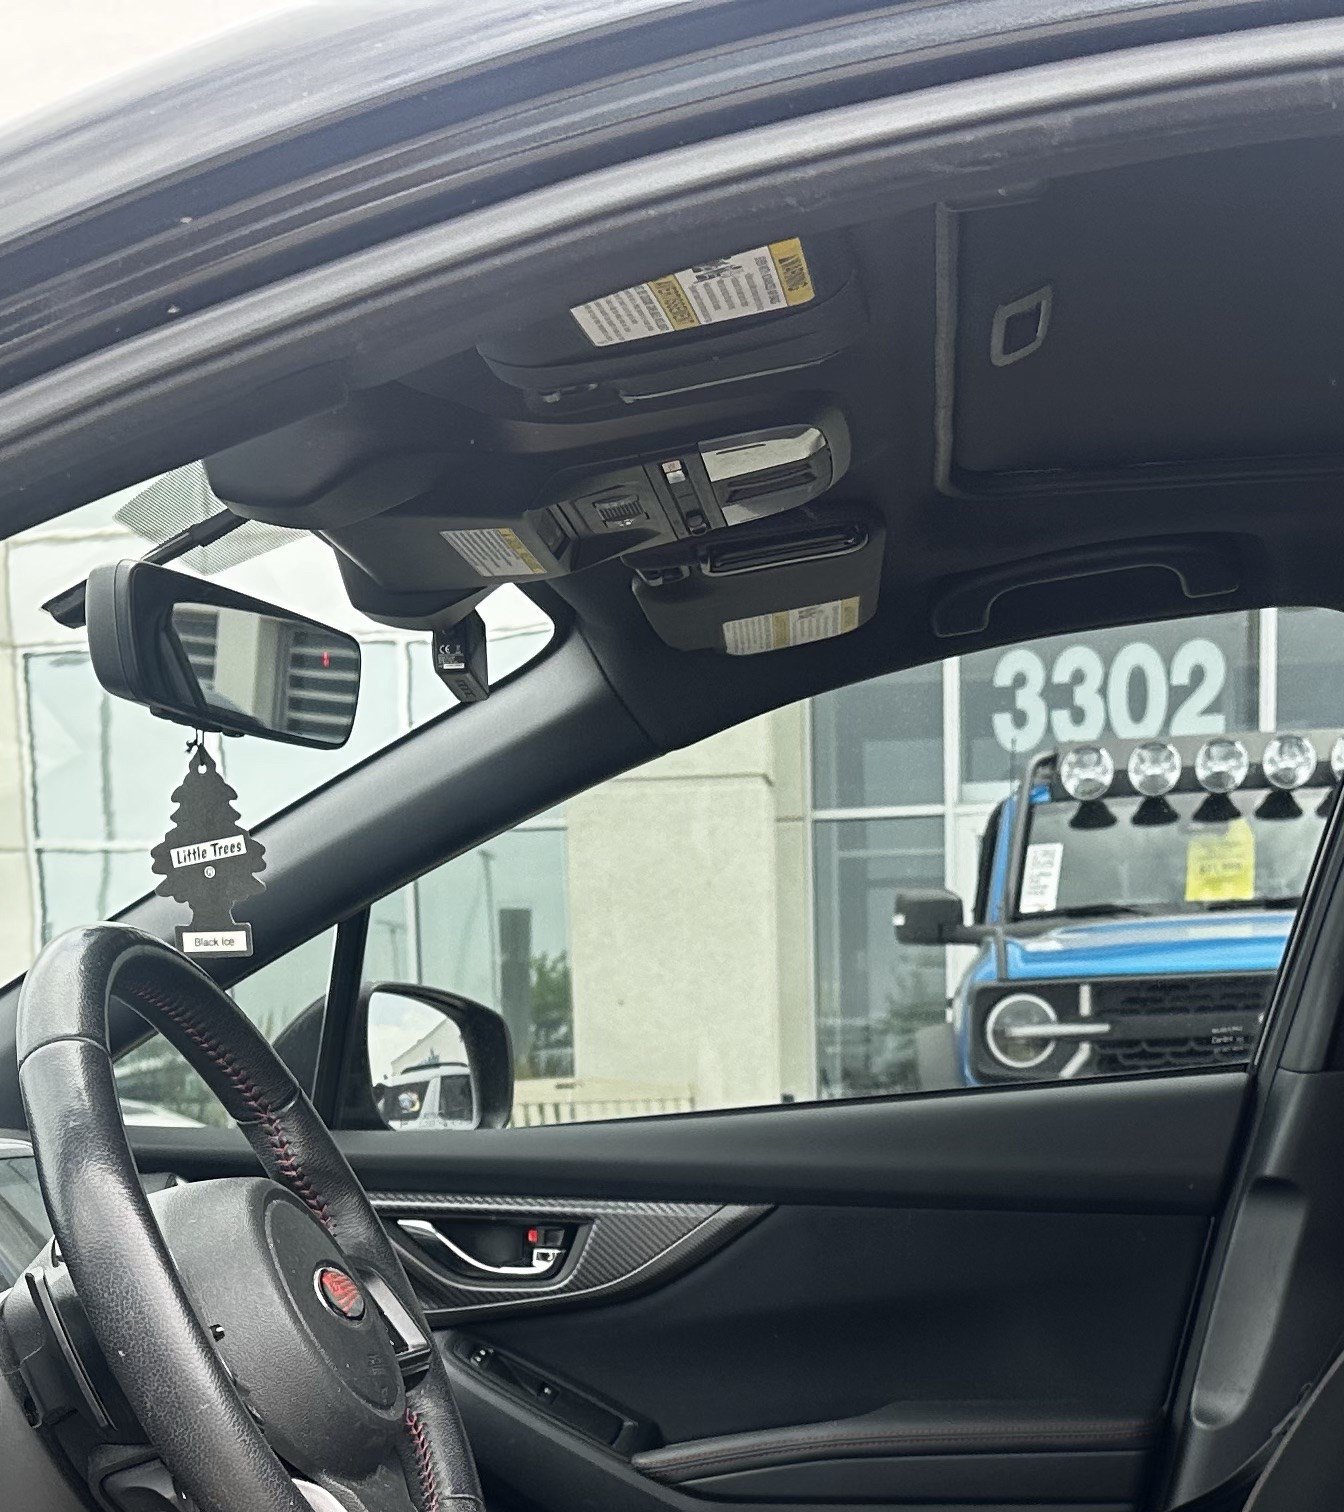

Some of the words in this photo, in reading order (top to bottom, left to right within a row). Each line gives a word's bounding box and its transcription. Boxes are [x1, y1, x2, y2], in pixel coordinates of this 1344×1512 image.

[992, 638, 1226, 752] 3302
[177, 847, 207, 865] Little
[210, 843, 242, 858] Trees
[194, 937, 219, 947] Black
